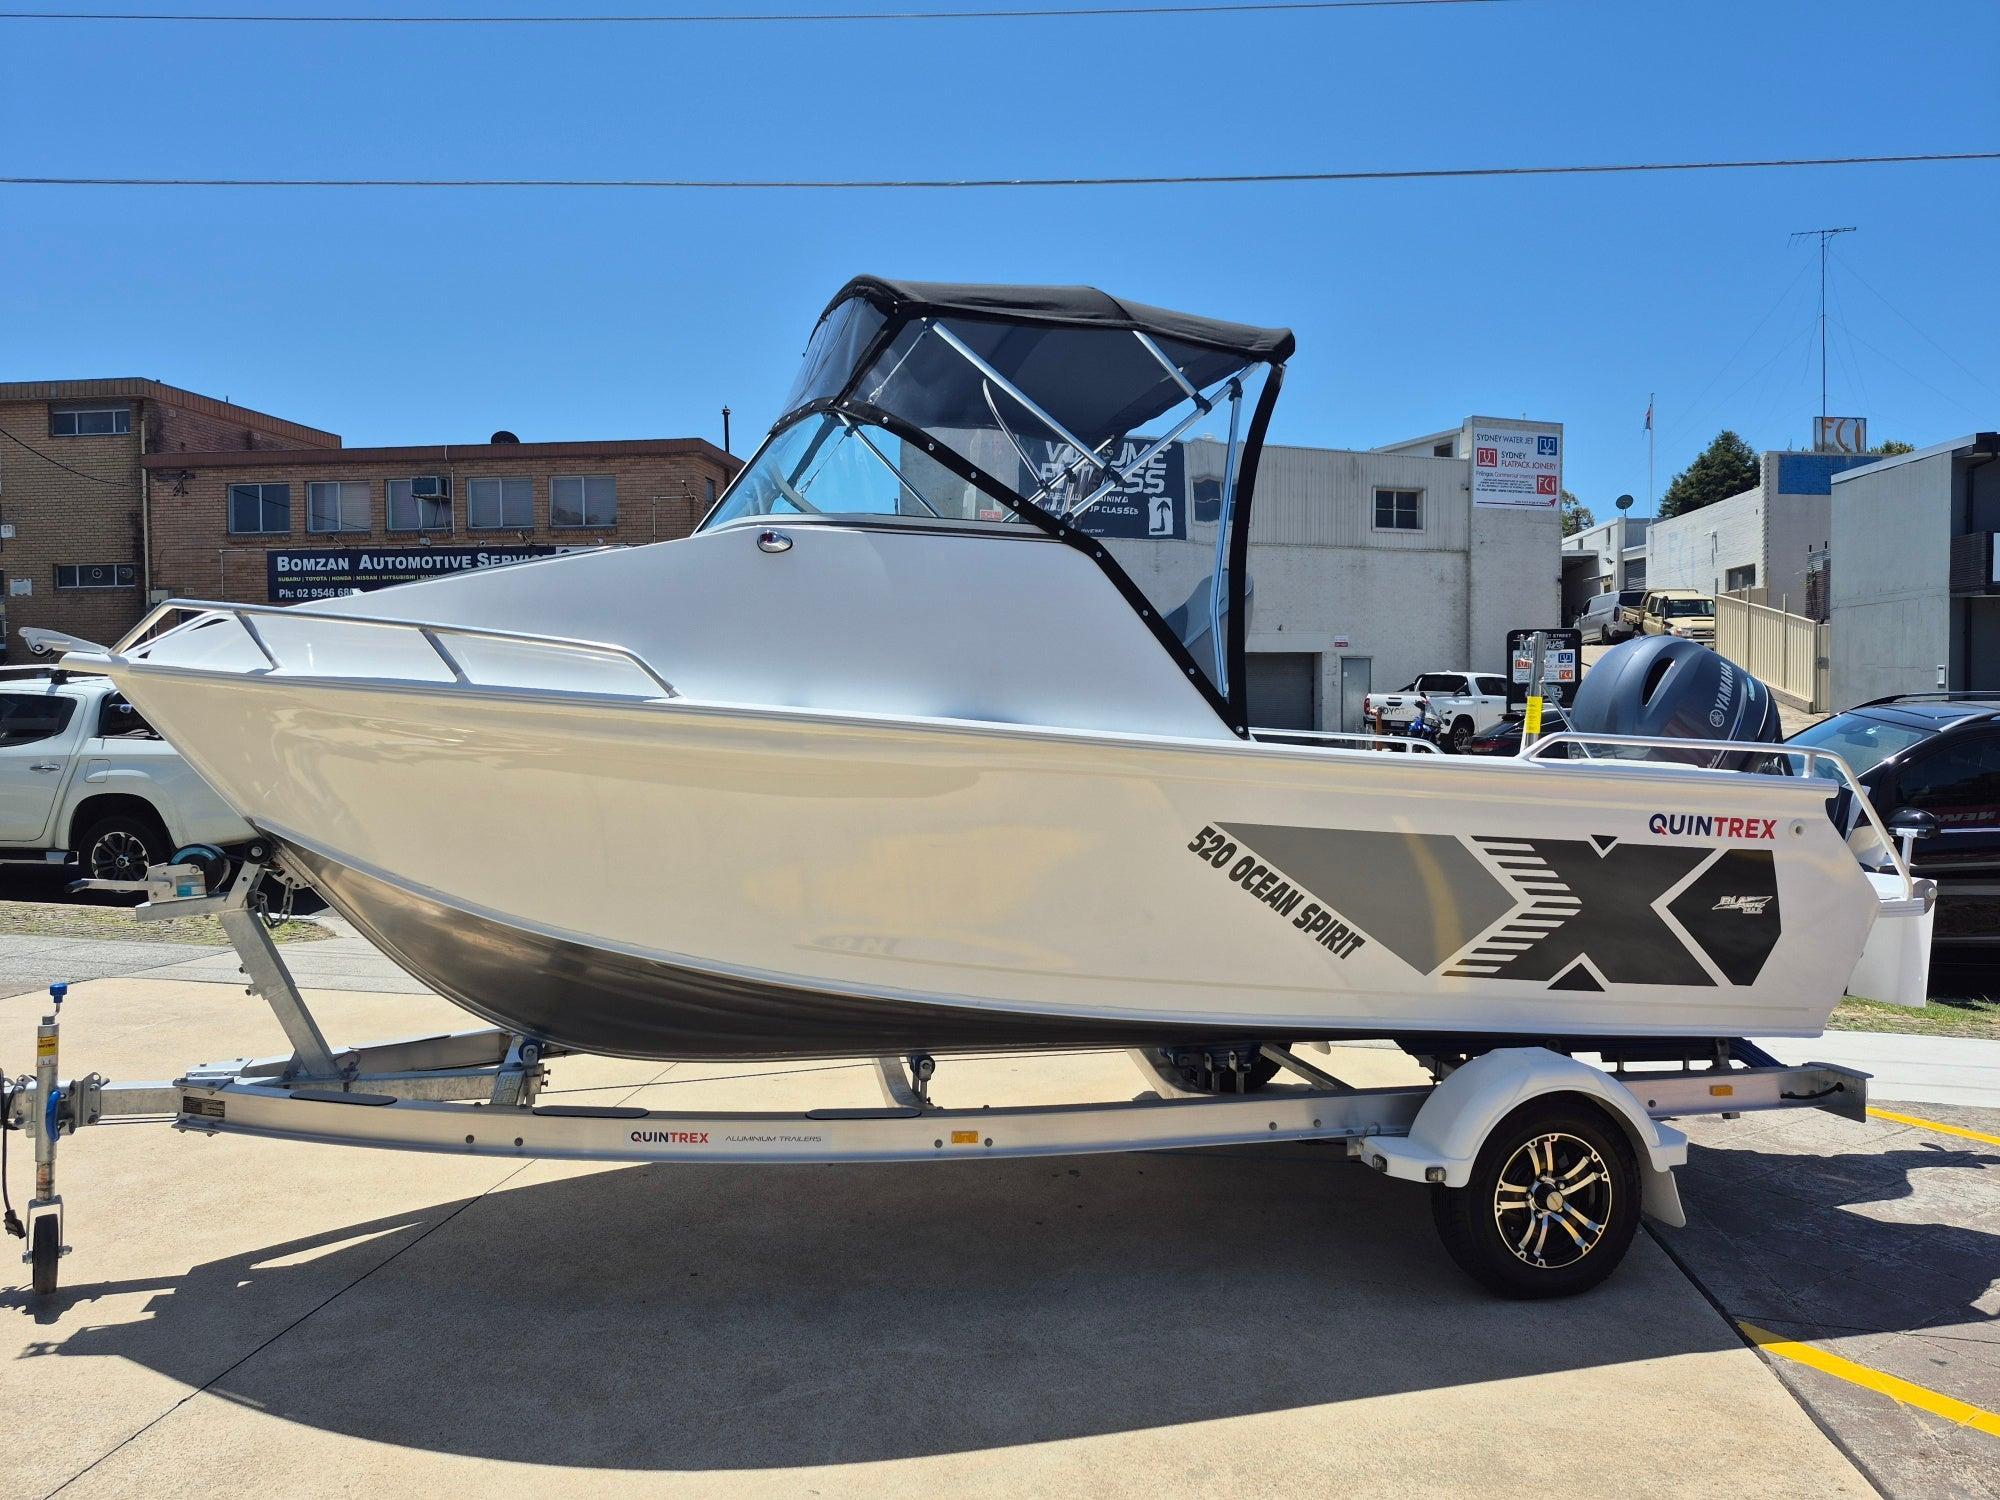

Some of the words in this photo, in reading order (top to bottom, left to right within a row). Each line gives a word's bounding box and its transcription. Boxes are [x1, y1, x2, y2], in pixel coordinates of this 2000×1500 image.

[1476, 434, 1501, 442] SYDNEY
[1503, 436, 1523, 444] WATER
[1501, 451, 1527, 459] SYDNEY
[277, 556, 349, 571] BOMZAN
[358, 554, 471, 570] AUTOMOTIVE
[278, 588, 294, 598] Ph:
[296, 588, 309, 598] 02
[311, 588, 335, 597] 9546
[1714, 660, 1734, 712] YAMAHA
[1649, 813, 1777, 839] QUINTREX
[1187, 825, 1237, 869] 520
[1228, 855, 1304, 917] OCEAN
[1292, 903, 1366, 960] SPIRIT
[630, 1131, 709, 1143] QUINTREX
